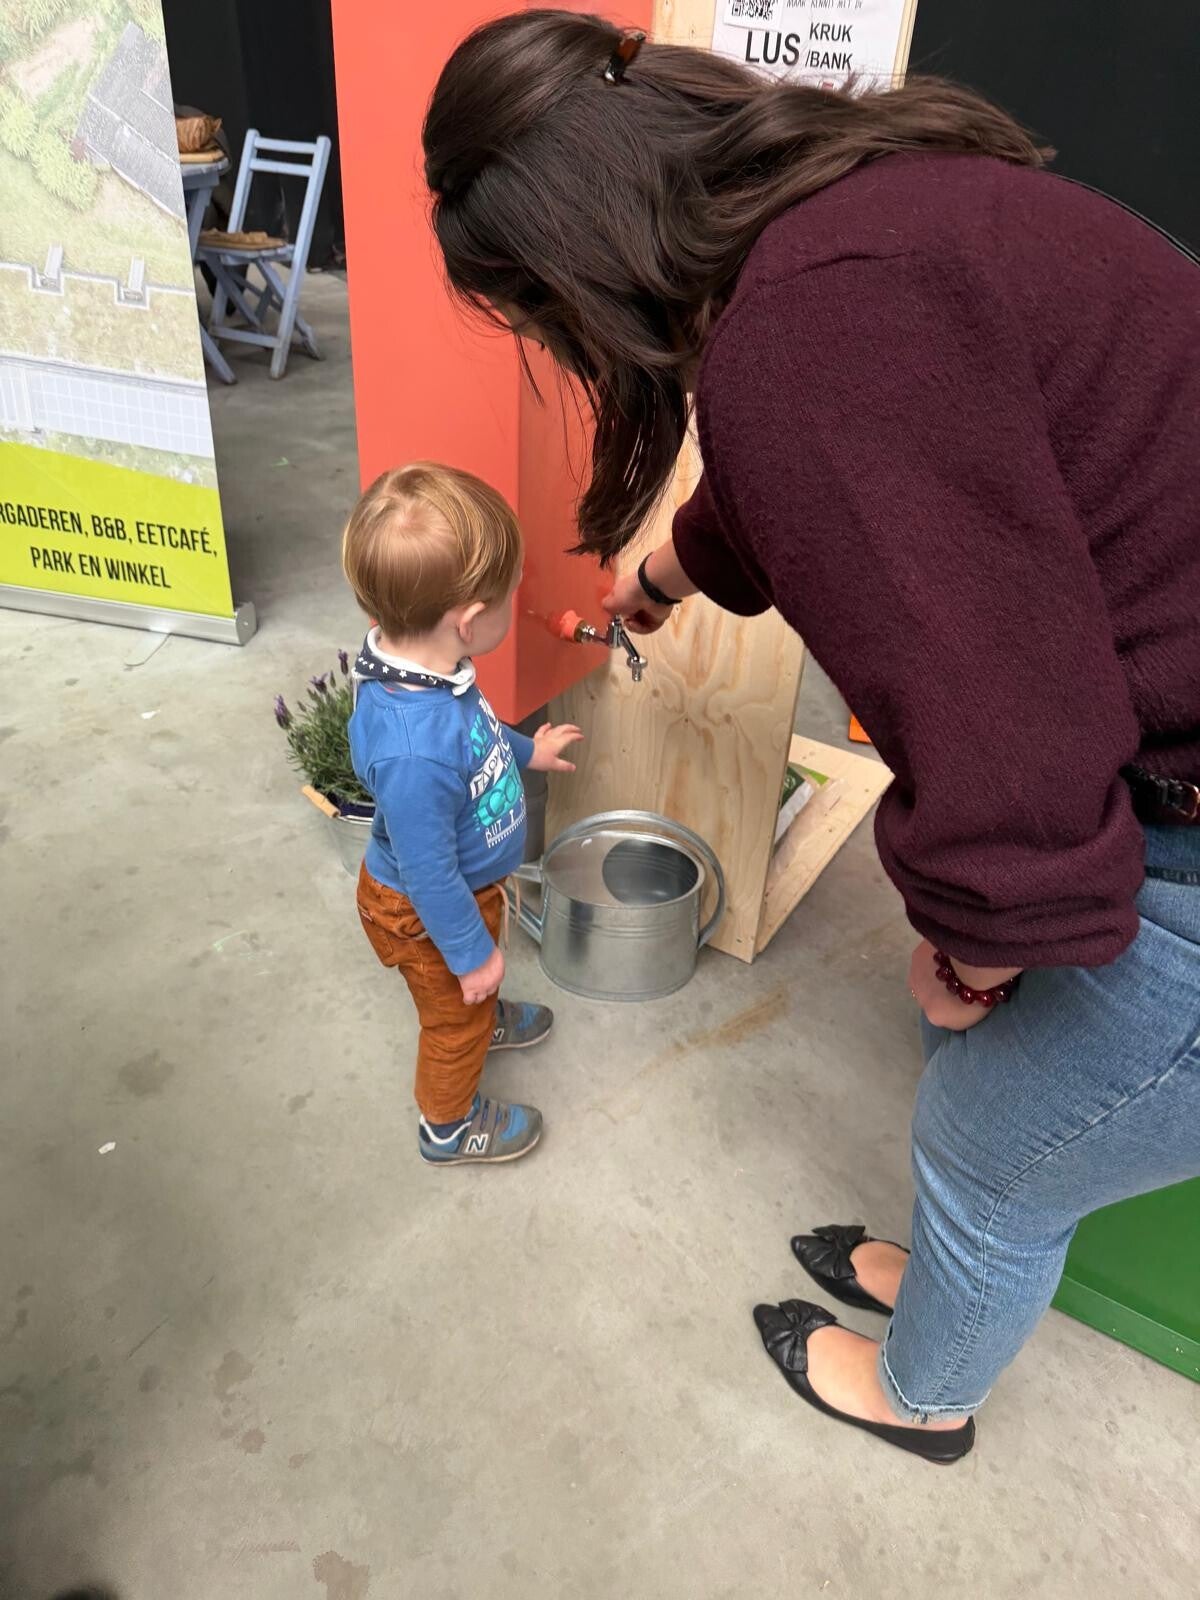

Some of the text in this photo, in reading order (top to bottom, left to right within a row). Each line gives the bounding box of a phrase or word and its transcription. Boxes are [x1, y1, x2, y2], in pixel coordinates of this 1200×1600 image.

[809, 22, 853, 42] KRUK
[745, 31, 801, 66] LUS
[804, 49, 853, 70] /BANK
[91, 514, 133, 544] B&B,
[136, 521, 218, 557] EETCAFÉ,
[30, 546, 172, 588] PARK EN WINKEL
[464, 1134, 489, 1153] N
